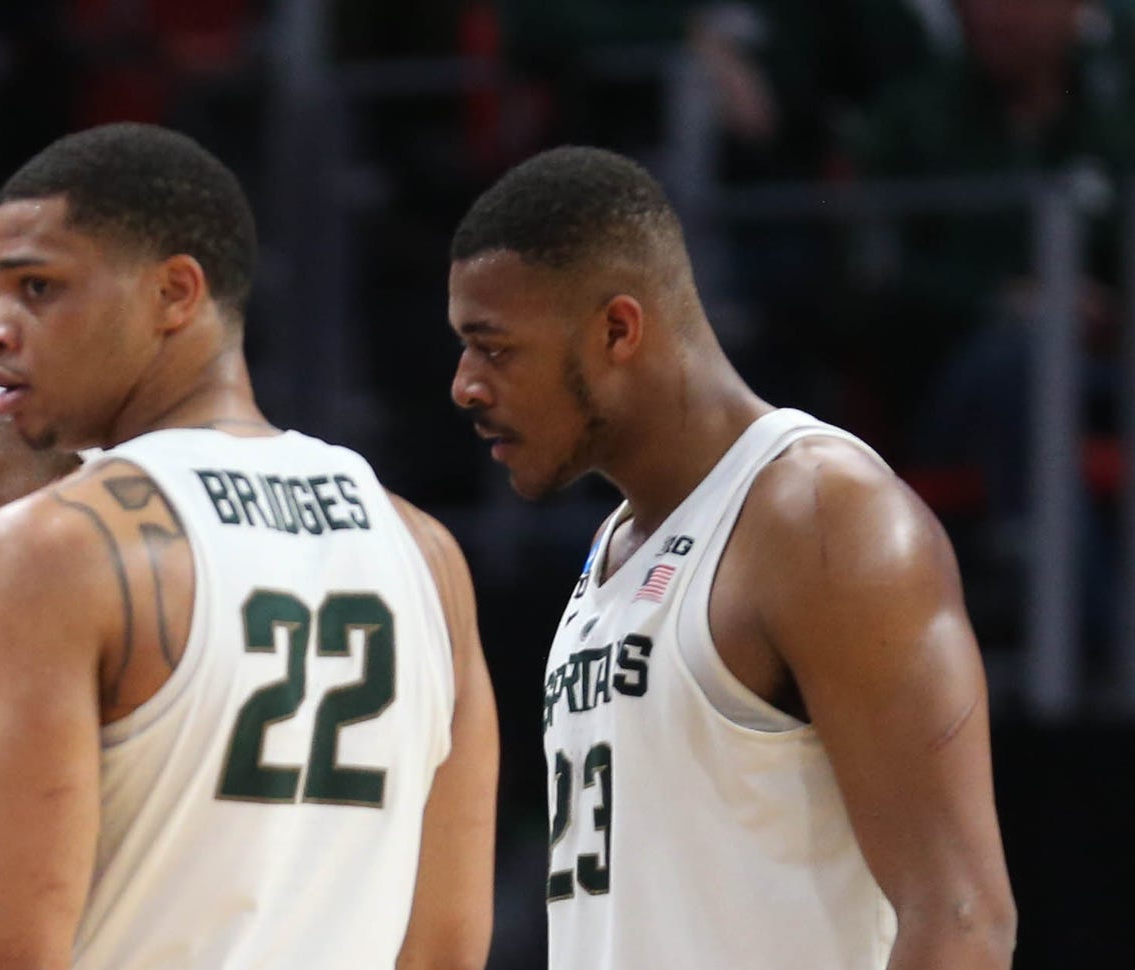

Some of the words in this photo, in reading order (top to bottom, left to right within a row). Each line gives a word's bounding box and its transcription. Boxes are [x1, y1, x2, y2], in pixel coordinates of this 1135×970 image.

[194, 469, 370, 535] BRIDGES
[214, 586, 397, 809] 22
[547, 741, 613, 904] 23
